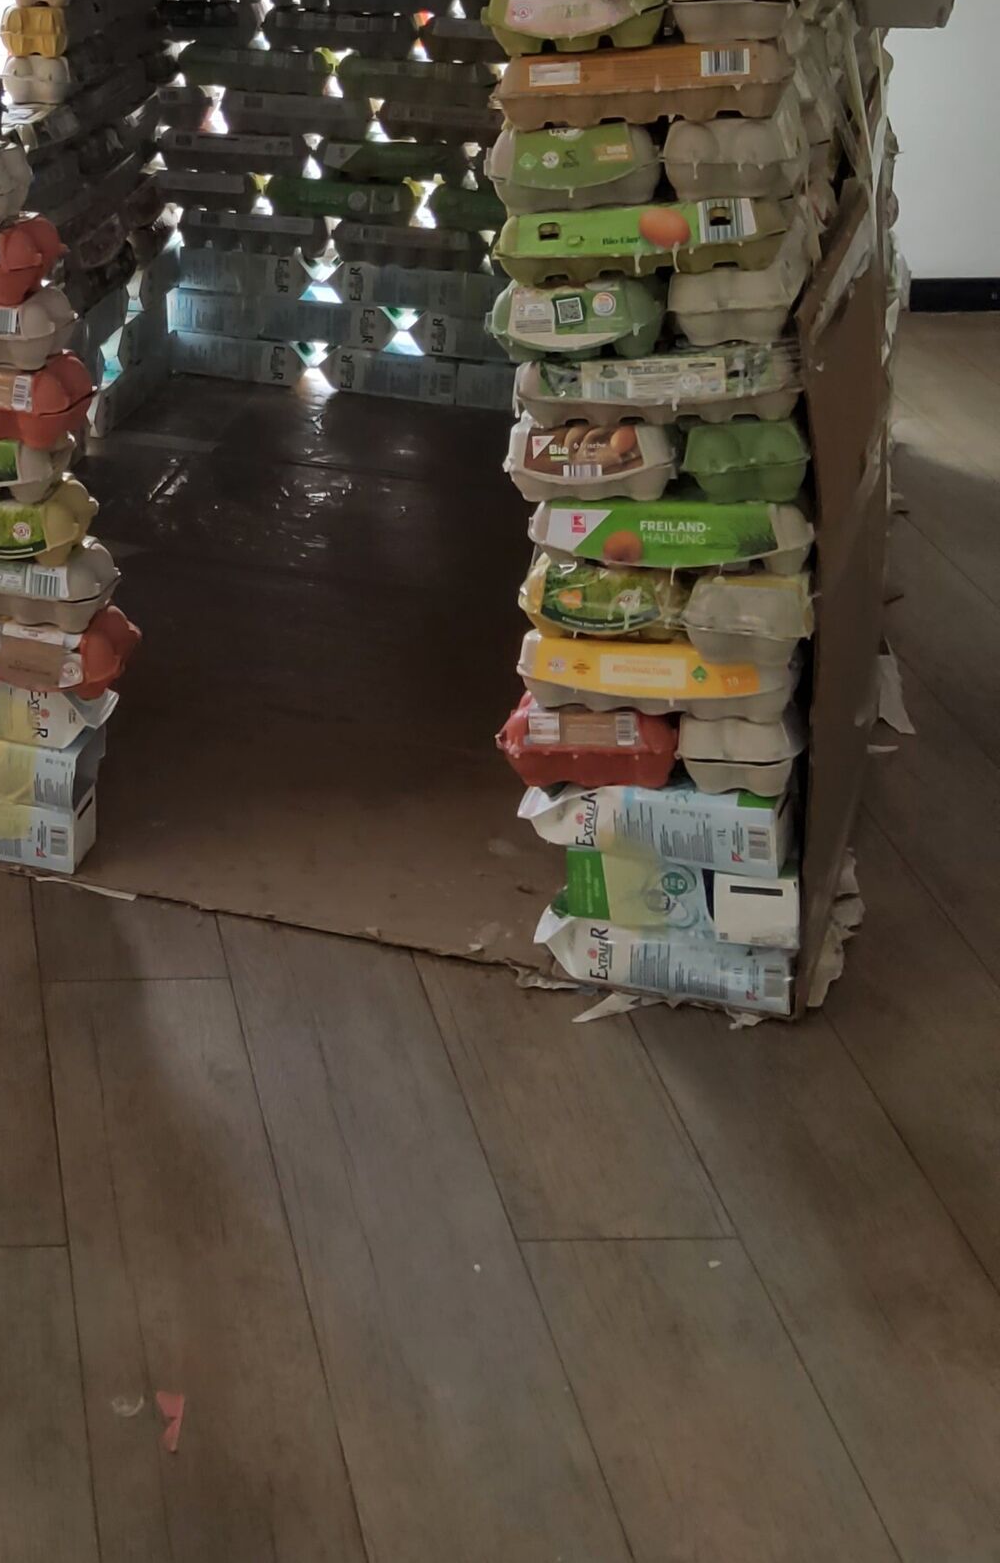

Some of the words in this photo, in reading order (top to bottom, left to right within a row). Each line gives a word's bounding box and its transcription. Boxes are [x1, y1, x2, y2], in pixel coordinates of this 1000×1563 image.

[549, 444, 569, 455] Bio
[639, 520, 712, 532] FREILAND-
[643, 533, 707, 545] HALTUNG
[590, 927, 609, 981] EXTALER
